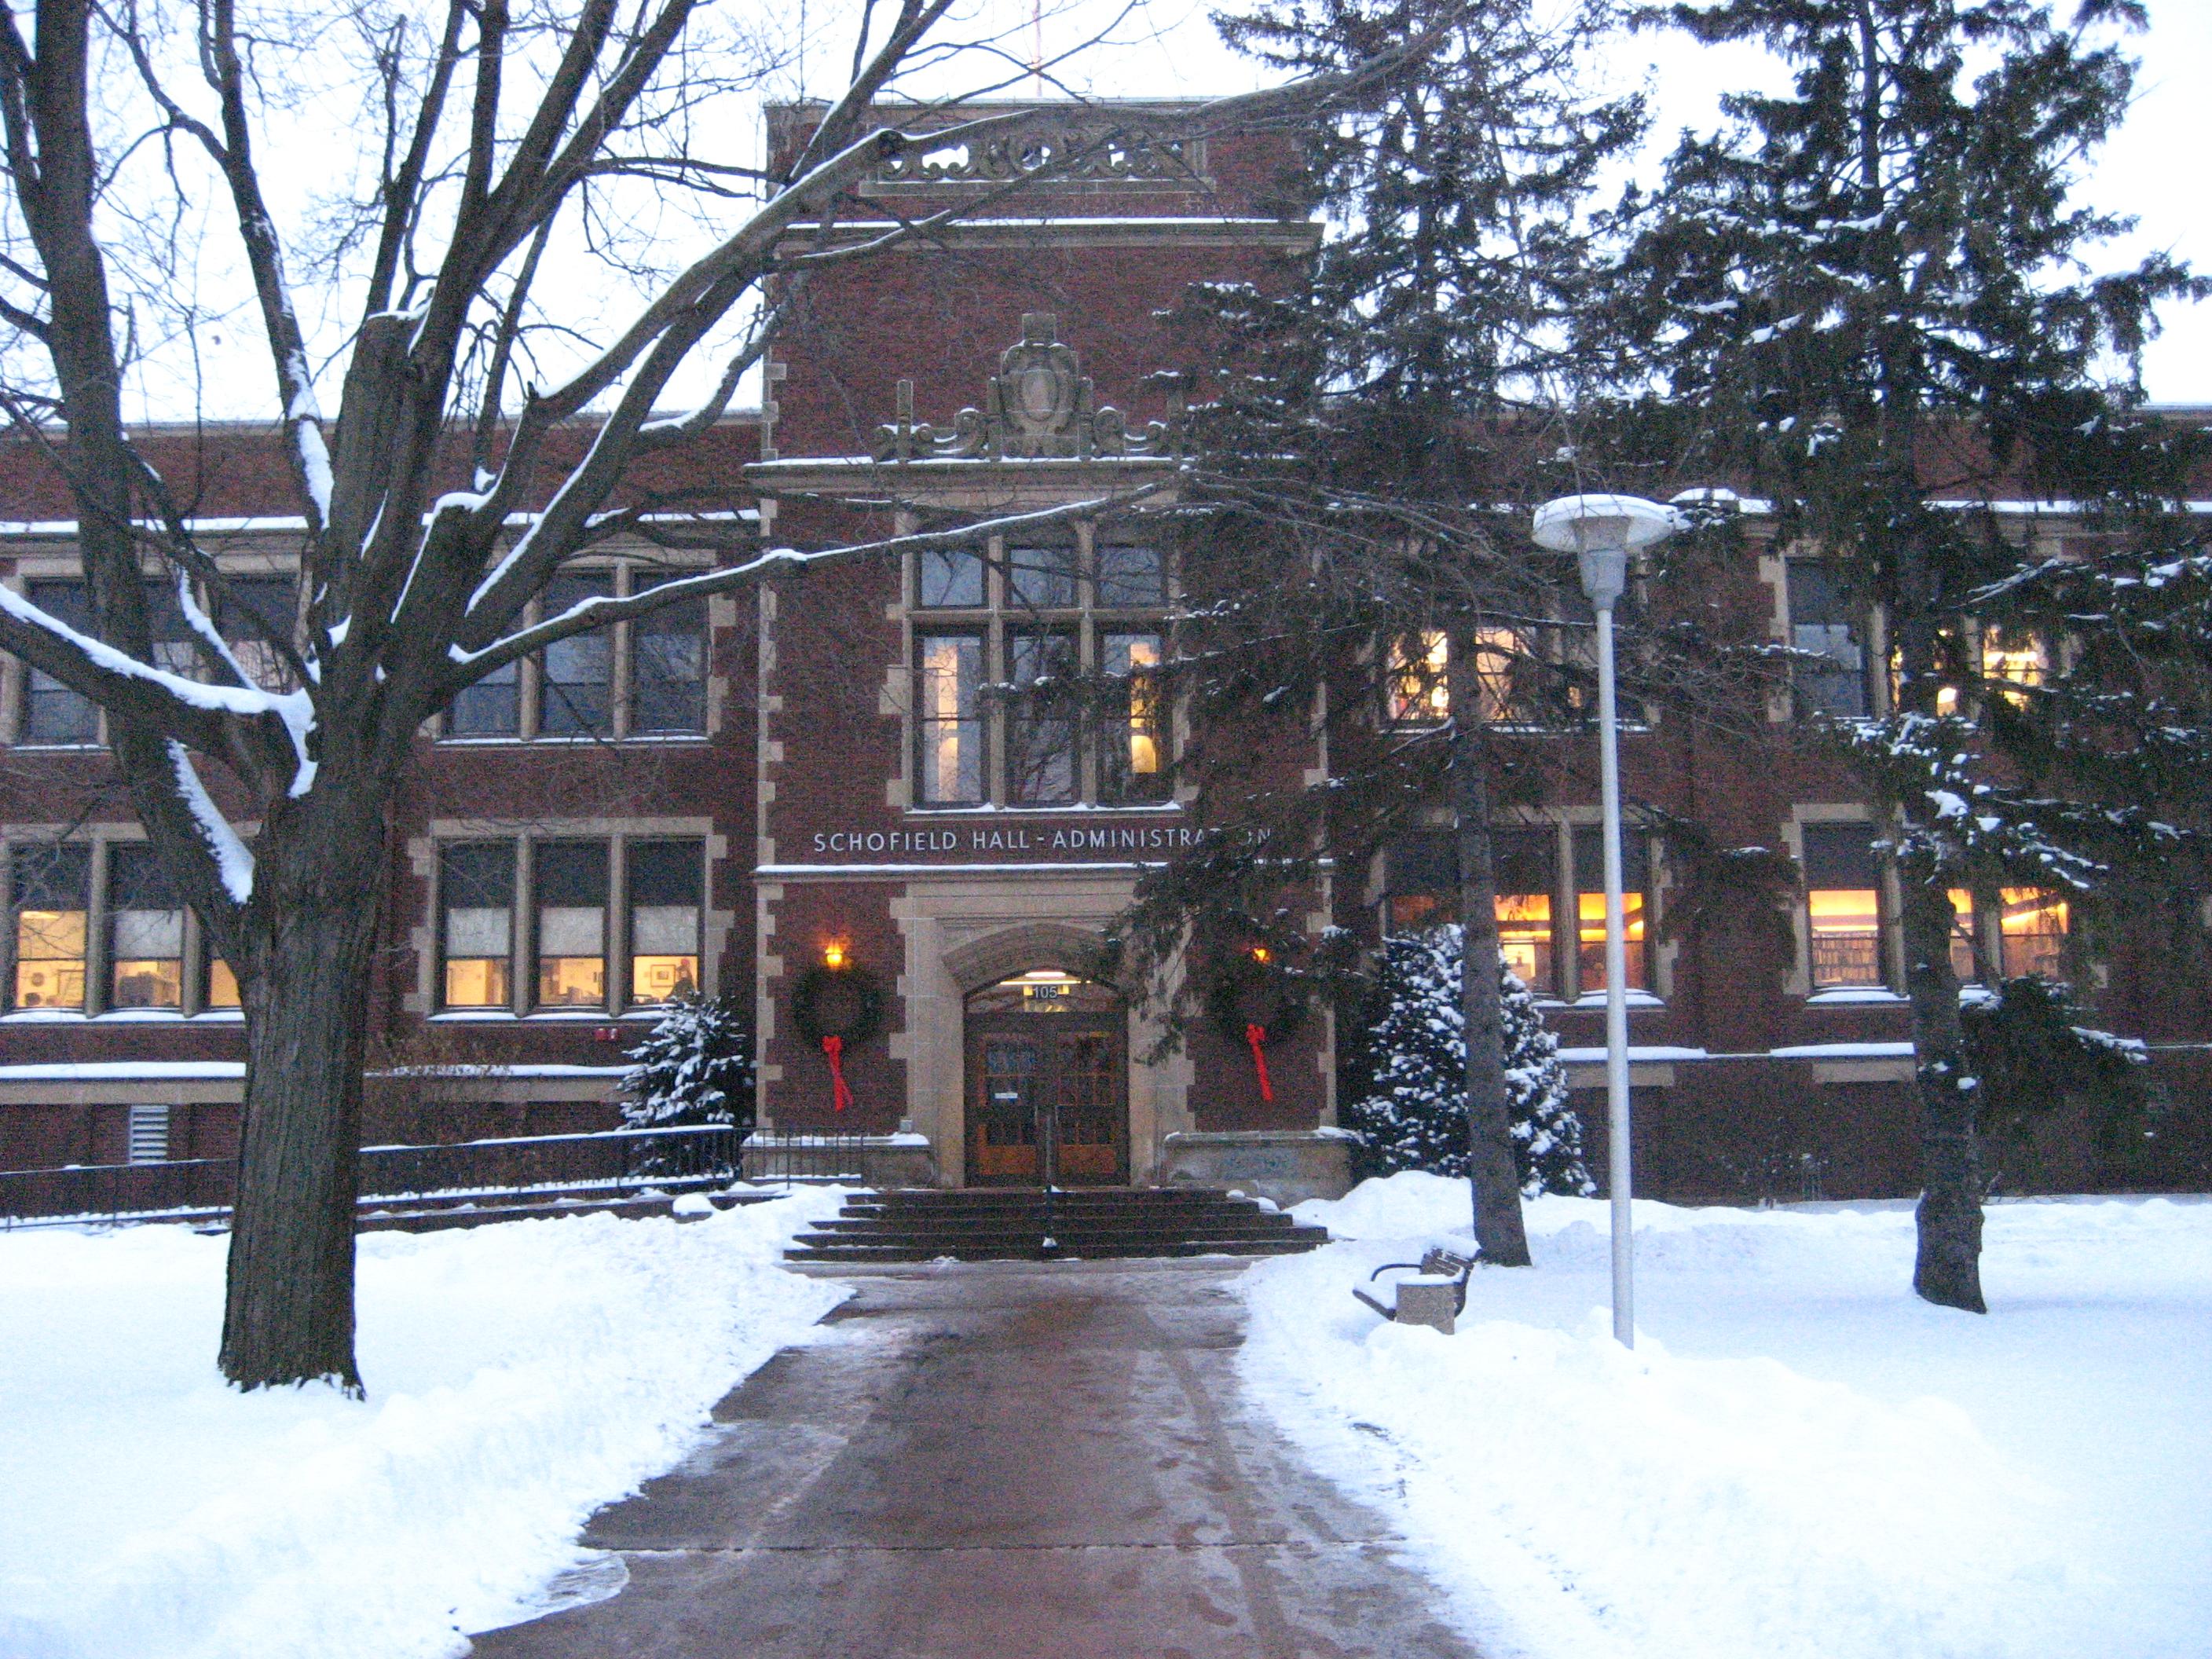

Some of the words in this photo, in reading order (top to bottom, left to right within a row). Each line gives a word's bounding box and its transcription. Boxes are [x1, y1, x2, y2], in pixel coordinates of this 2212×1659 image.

[814, 832, 957, 851] SCHOFIELD
[973, 830, 1030, 849] HALL
[1053, 828, 1271, 848] ADMINISTRAN
[1034, 986, 1057, 998] 105
